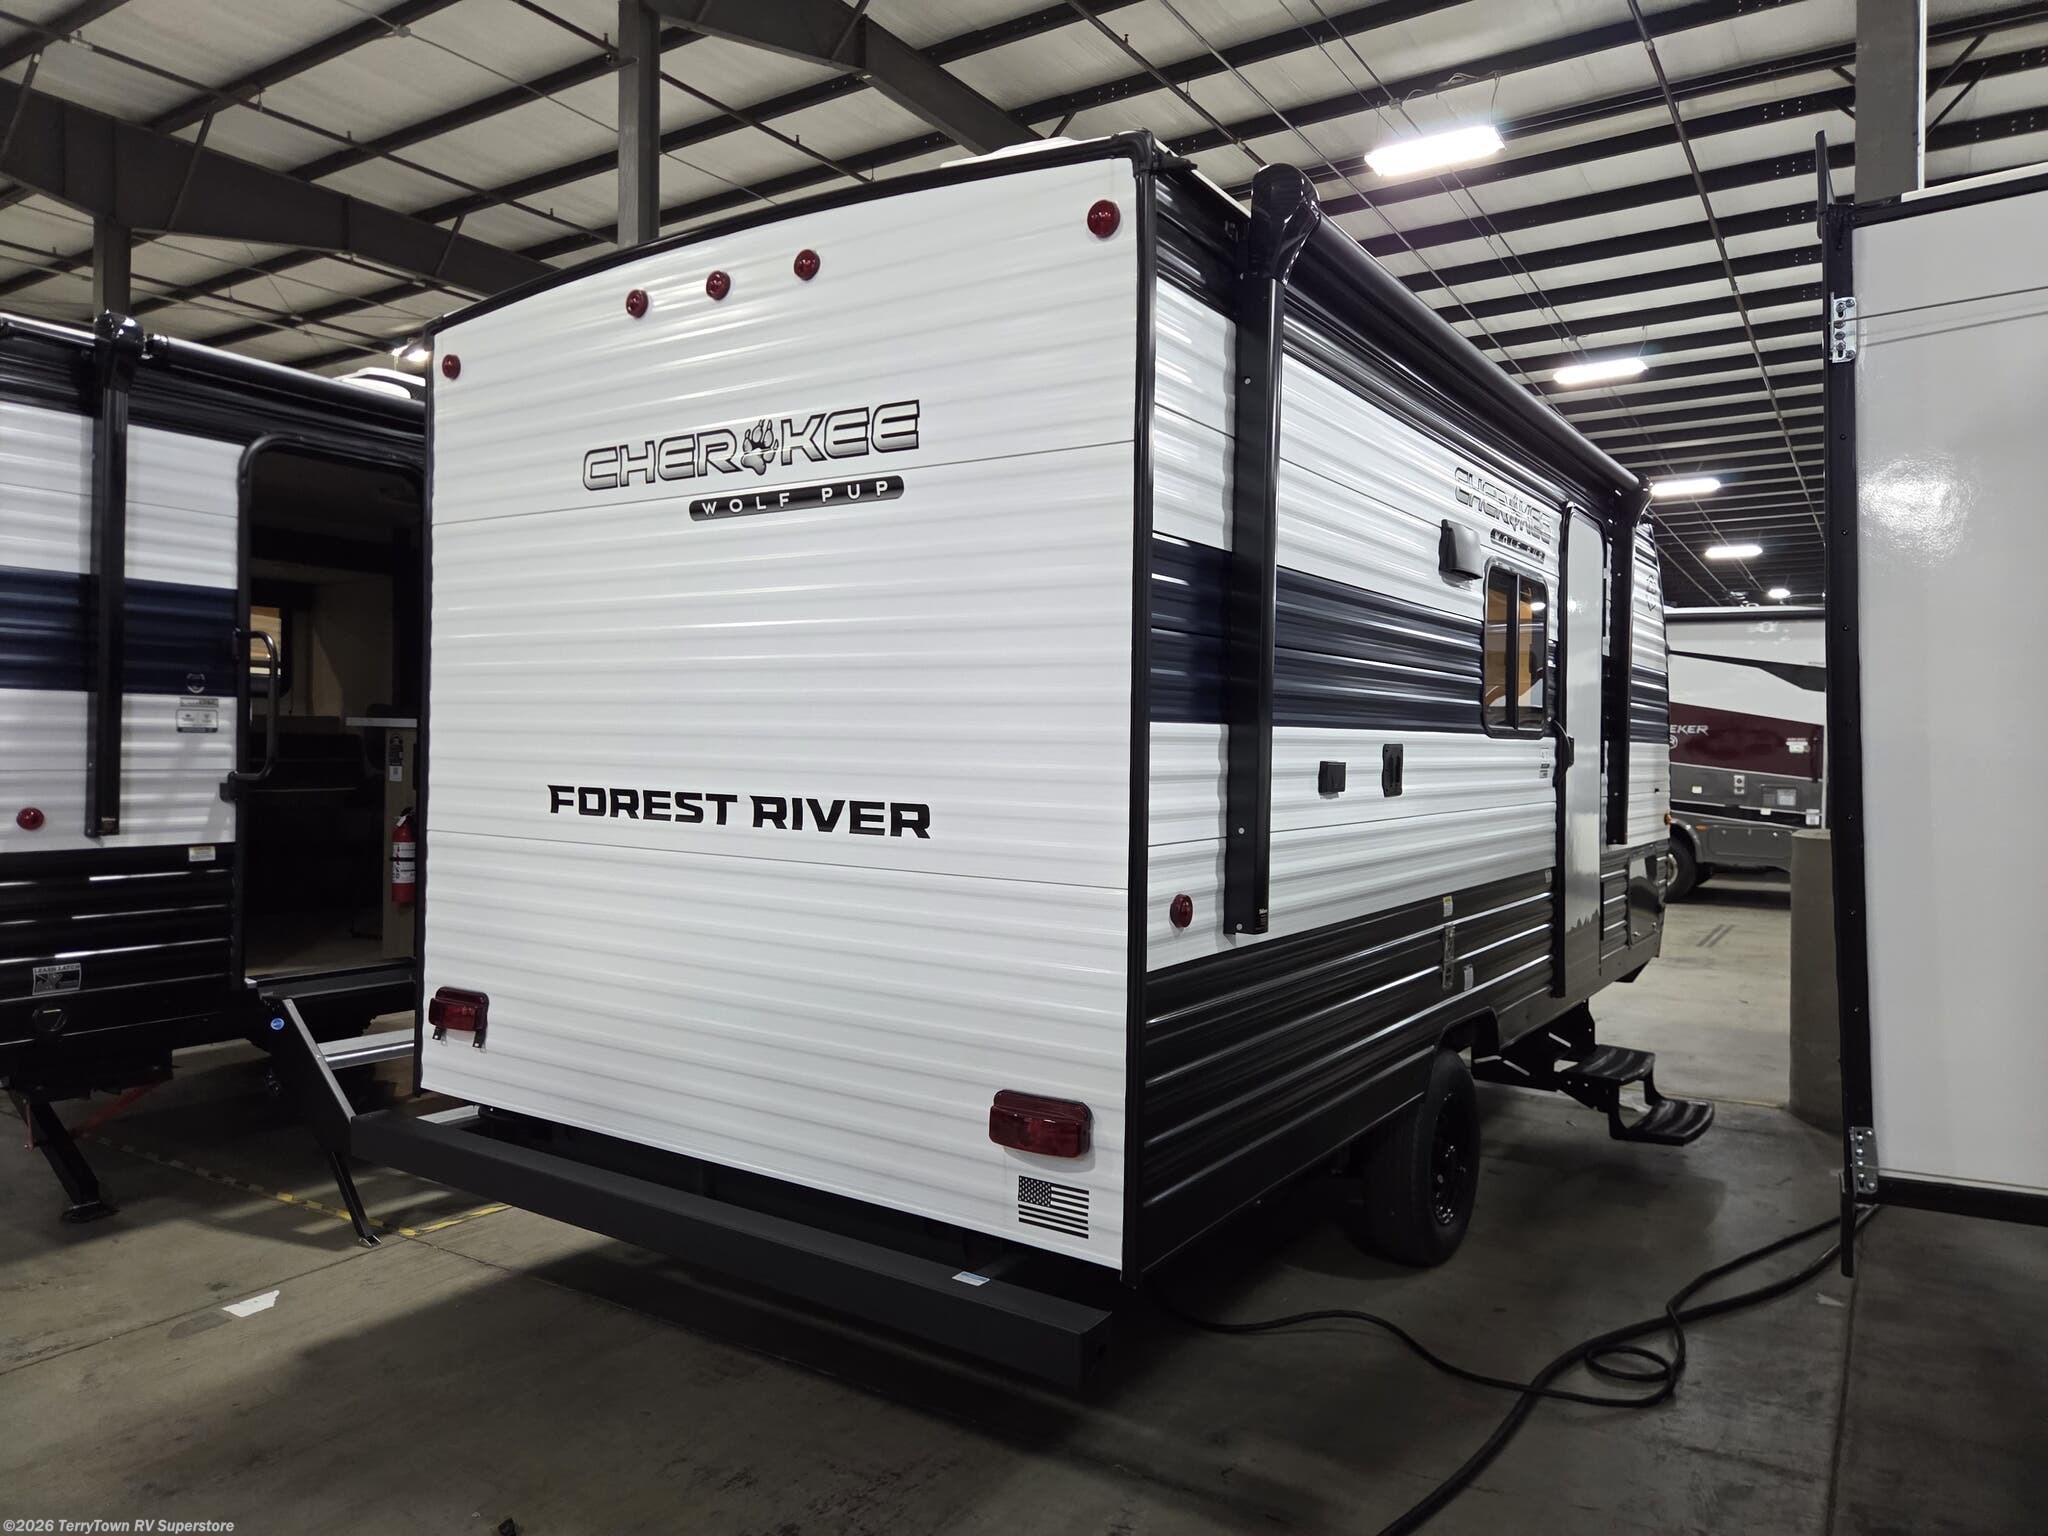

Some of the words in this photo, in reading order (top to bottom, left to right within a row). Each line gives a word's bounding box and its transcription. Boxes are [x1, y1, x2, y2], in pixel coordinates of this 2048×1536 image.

[702, 492, 790, 516] WOLF
[821, 480, 889, 503] PUP
[1670, 724, 1709, 736] EKER
[547, 784, 738, 826] FOREST
[749, 795, 931, 840] RIVER
